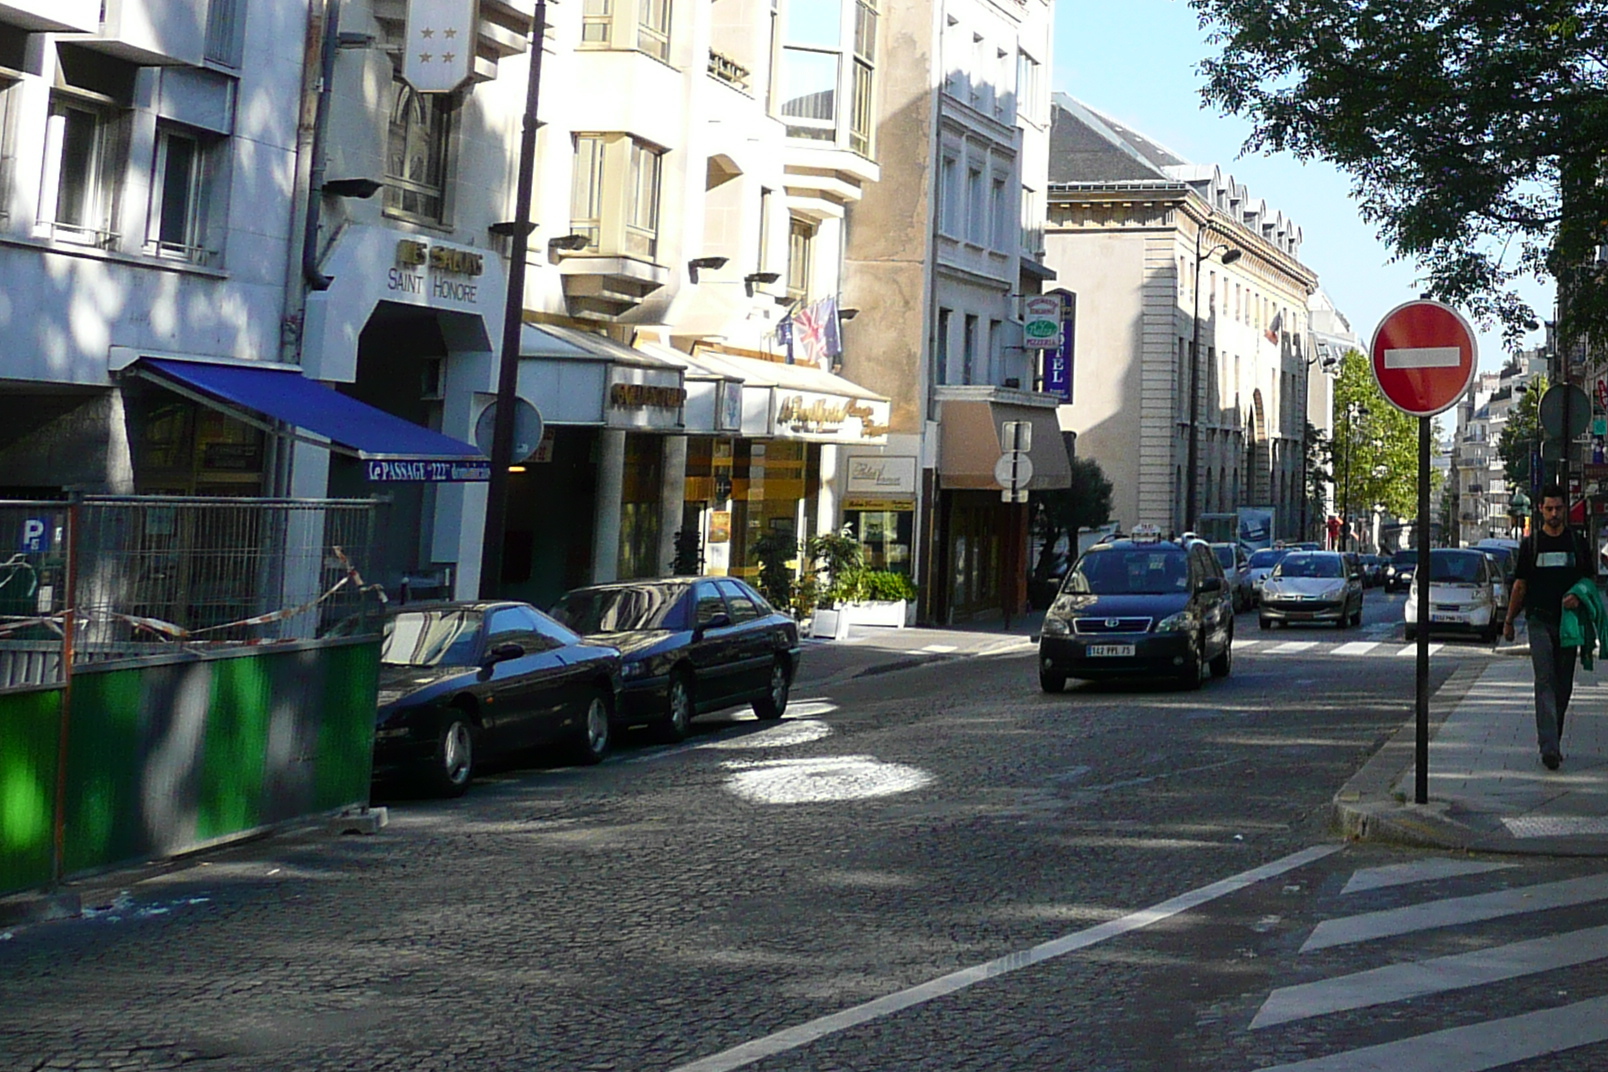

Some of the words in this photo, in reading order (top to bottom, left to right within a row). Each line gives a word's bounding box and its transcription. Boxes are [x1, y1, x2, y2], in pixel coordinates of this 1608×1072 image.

[387, 268, 424, 294] SAINT
[433, 275, 478, 304] HONORE
[369, 461, 381, 480] Le
[381, 462, 426, 480] PASSAGE
[23, 519, 44, 544] P
